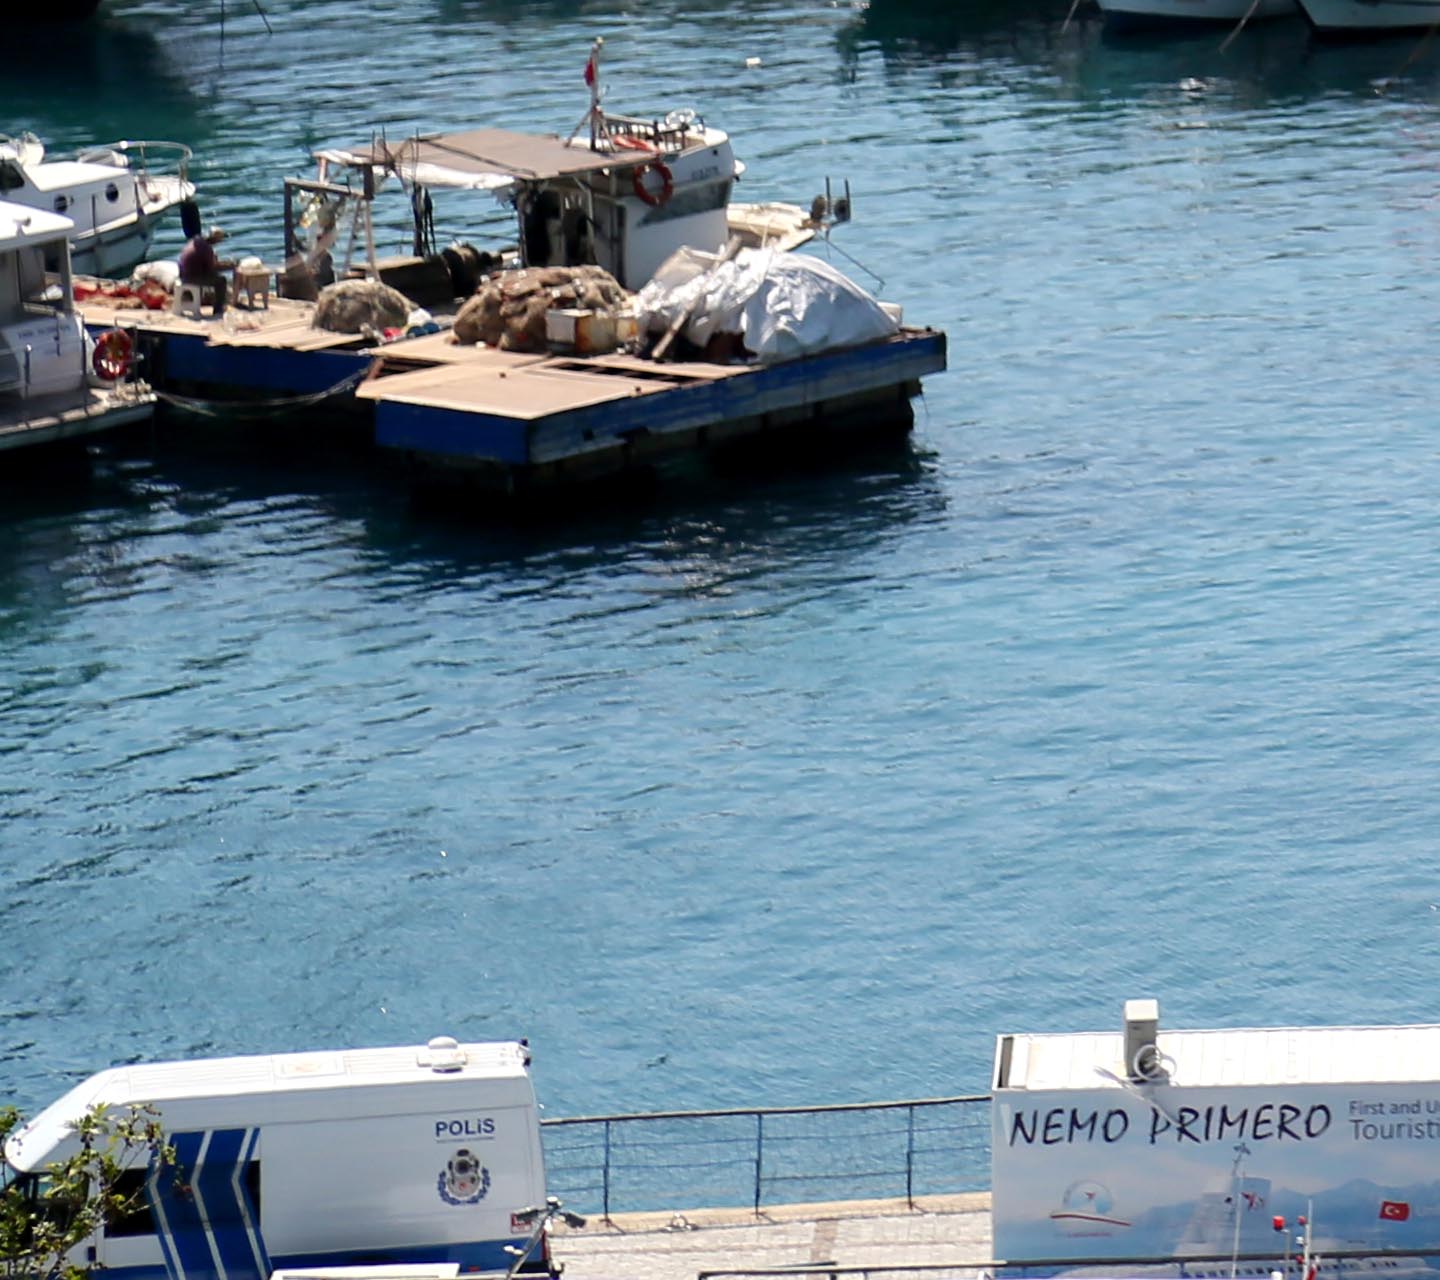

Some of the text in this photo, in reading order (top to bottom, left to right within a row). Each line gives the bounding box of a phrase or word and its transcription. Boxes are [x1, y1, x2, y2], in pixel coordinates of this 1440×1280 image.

[1348, 1100, 1384, 1115] First
[1389, 1099, 1422, 1115] and
[1009, 1103, 1332, 1147] NEMO PRIMERO
